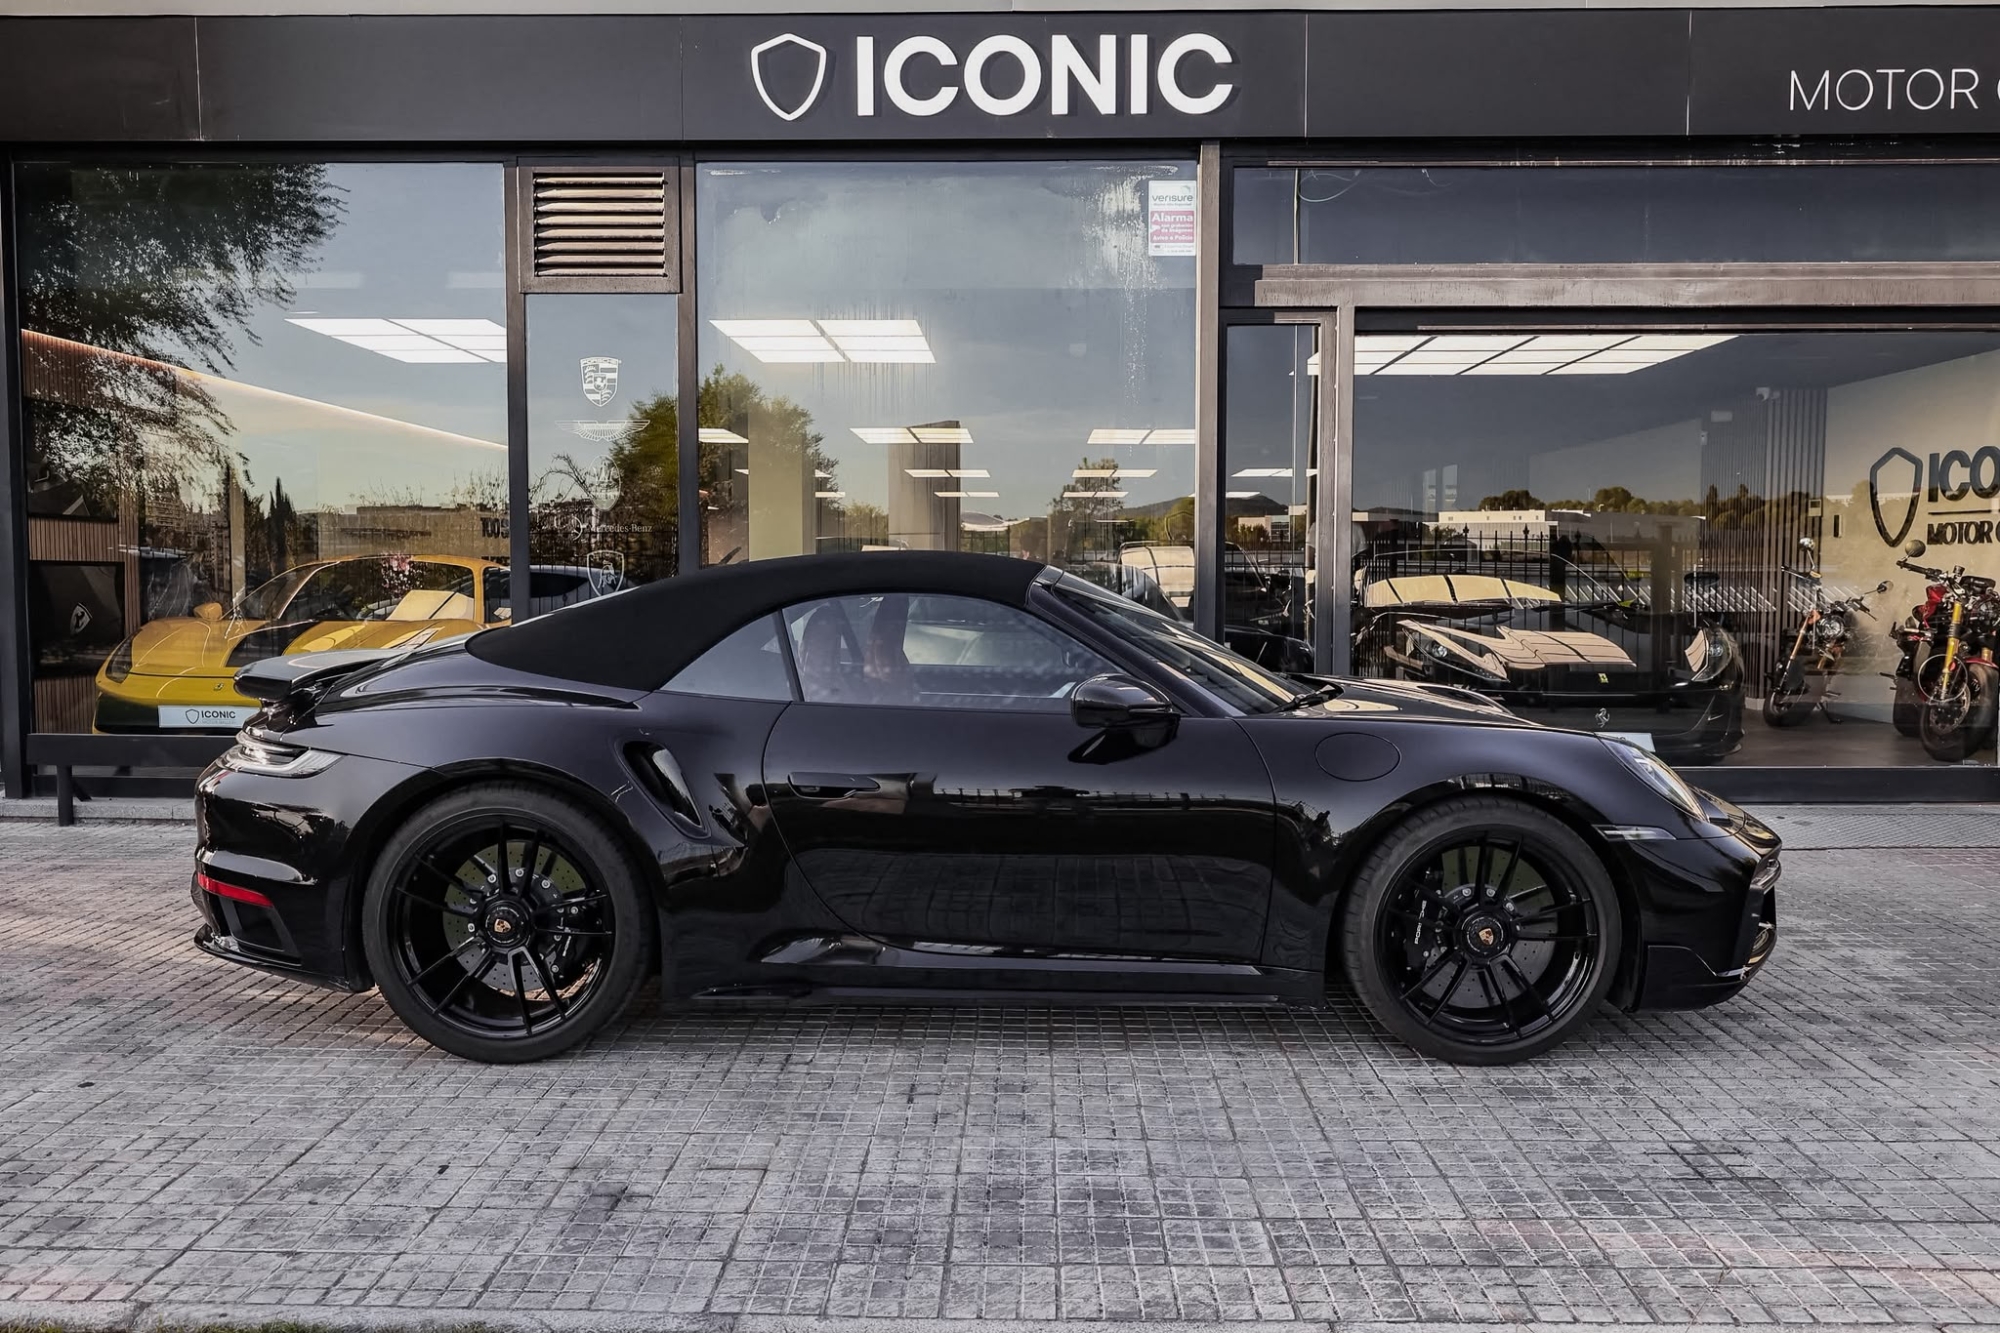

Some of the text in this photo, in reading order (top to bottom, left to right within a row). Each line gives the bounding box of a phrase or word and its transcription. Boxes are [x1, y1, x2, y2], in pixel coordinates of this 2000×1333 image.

[856, 33, 1234, 117] ICONIC
[1789, 68, 1979, 111] MOTOR
[1152, 213, 1193, 222] Alarma
[1927, 521, 1993, 545] MOTOR
[201, 710, 236, 719] ICONIC
